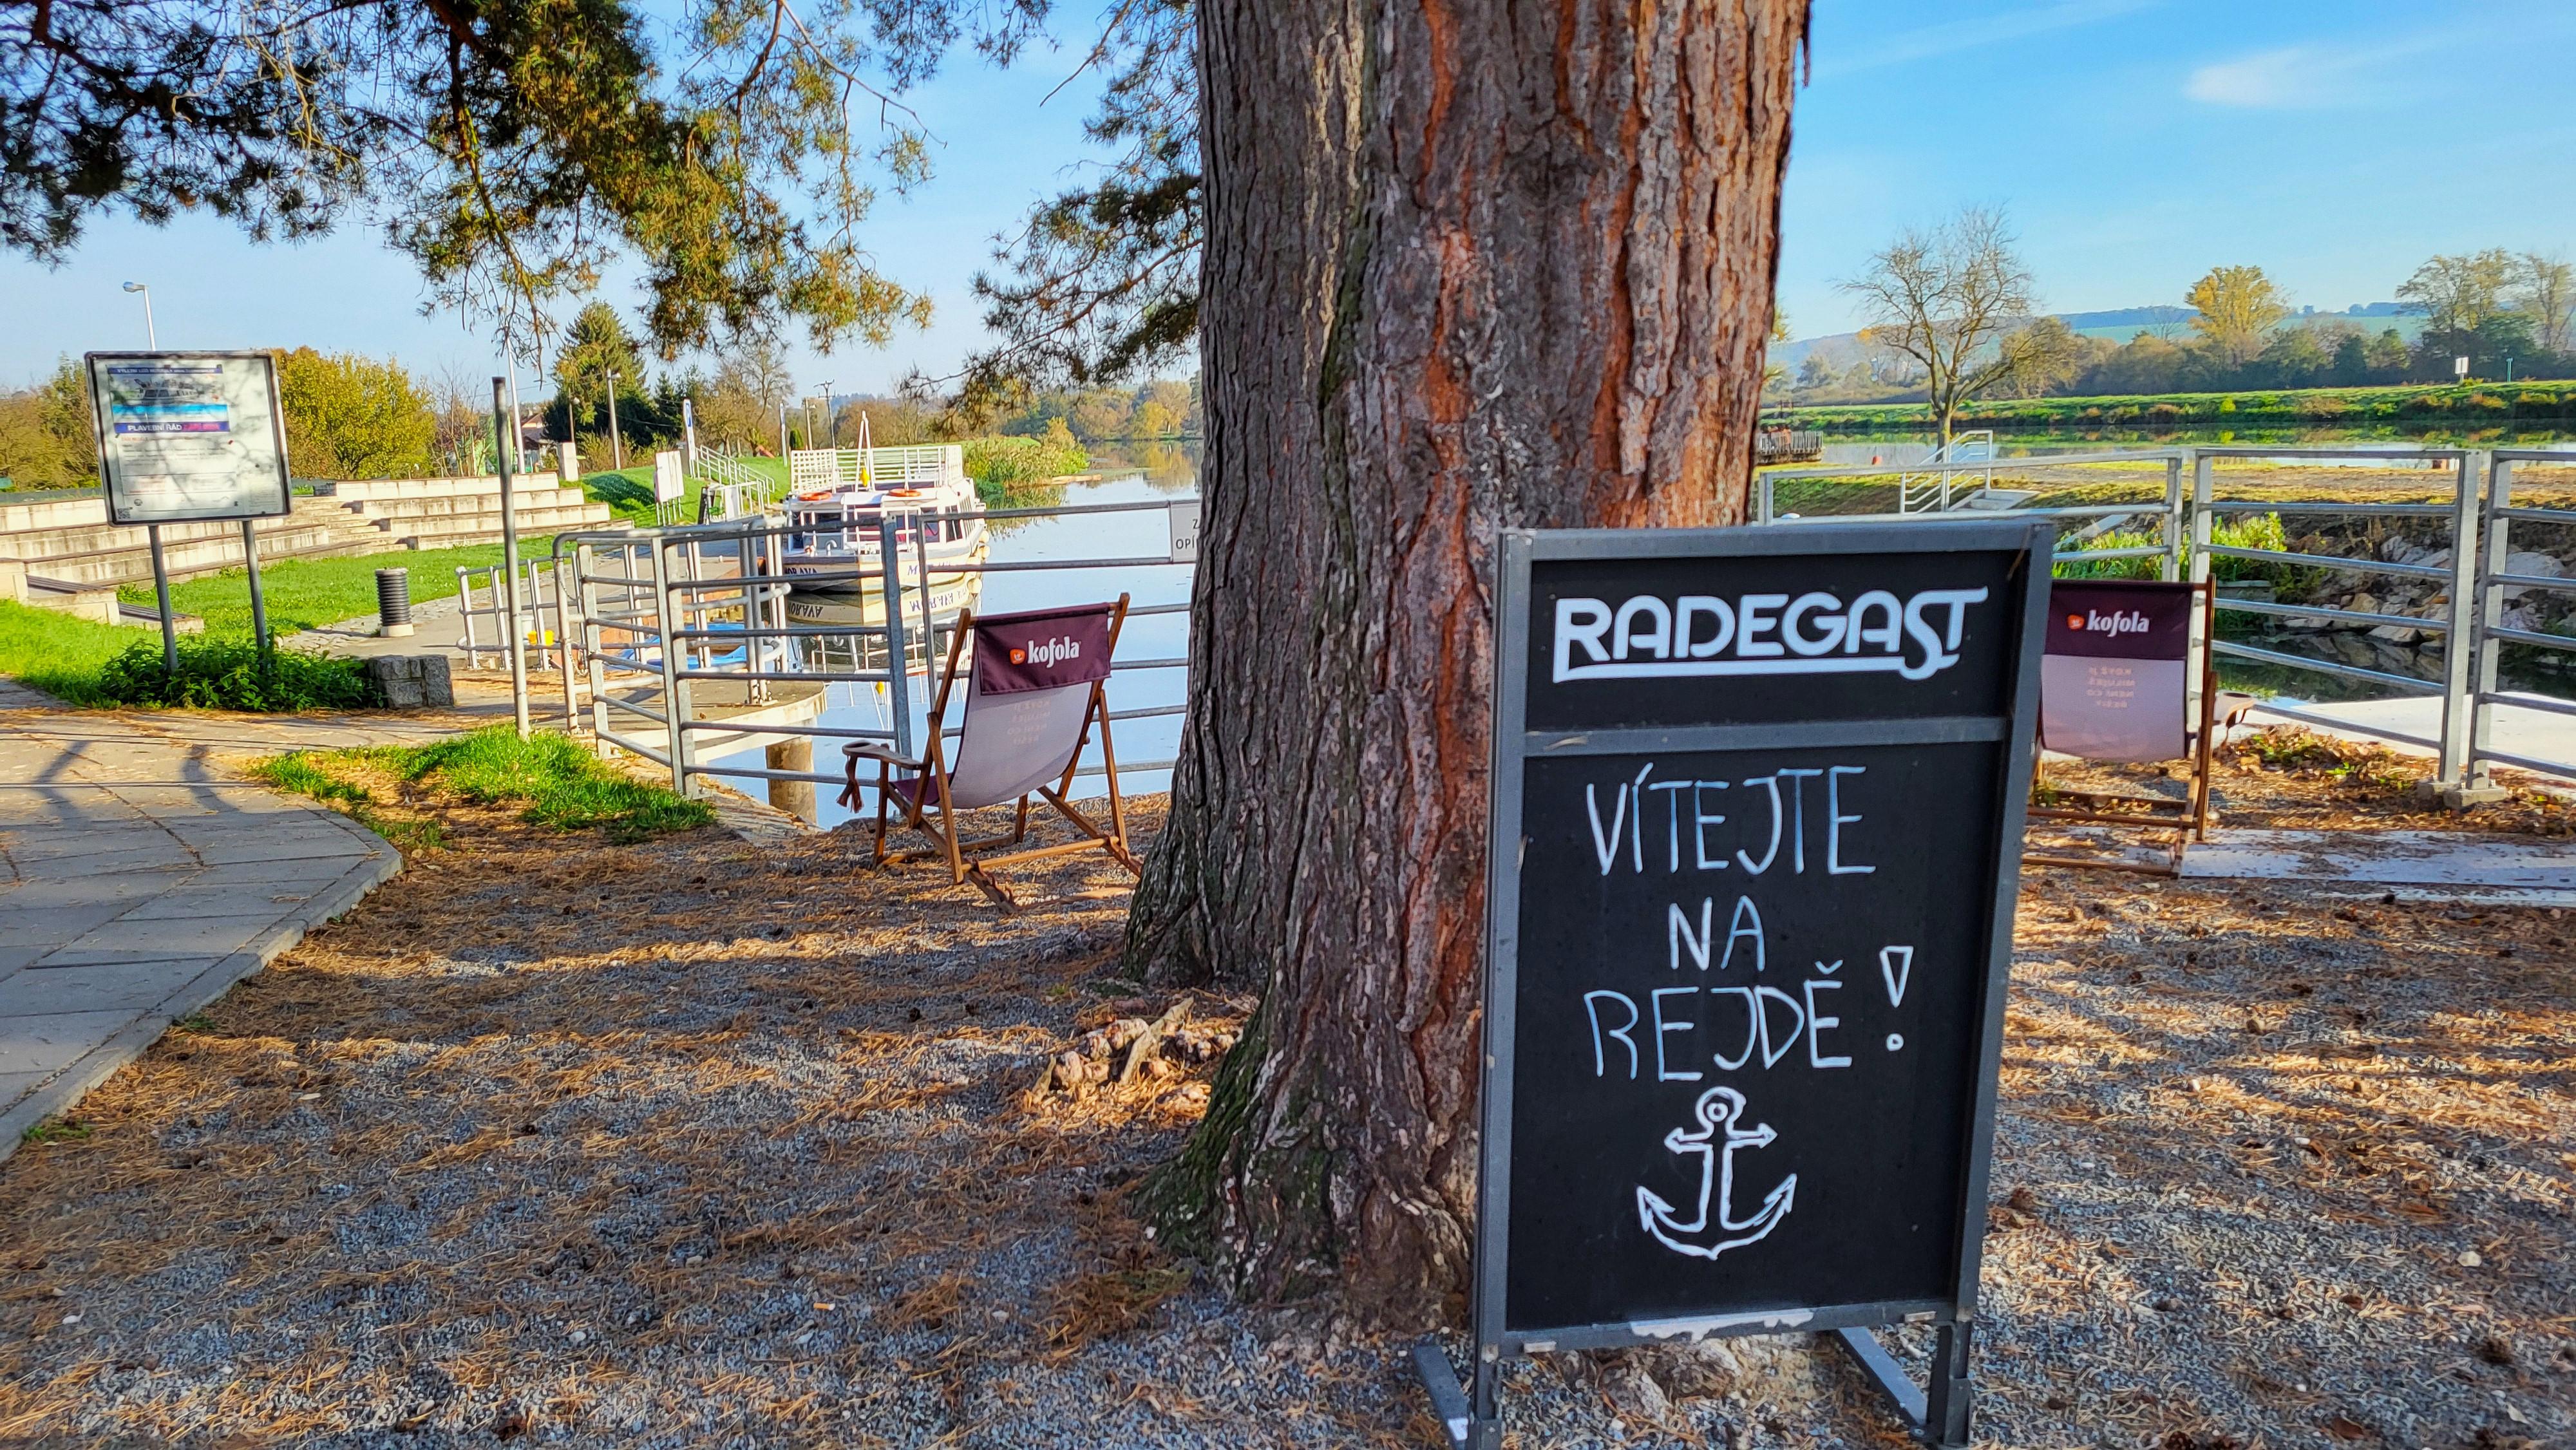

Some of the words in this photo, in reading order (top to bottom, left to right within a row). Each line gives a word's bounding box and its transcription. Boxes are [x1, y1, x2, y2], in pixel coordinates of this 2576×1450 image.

[1175, 534, 1198, 550] OPÍ
[1553, 586, 1989, 684] RADEGAST
[2086, 609, 2150, 637] kofola
[1027, 636, 1079, 668] kofola
[1586, 762, 1876, 876] VÍTEJTE
[1669, 895, 1765, 971] NA
